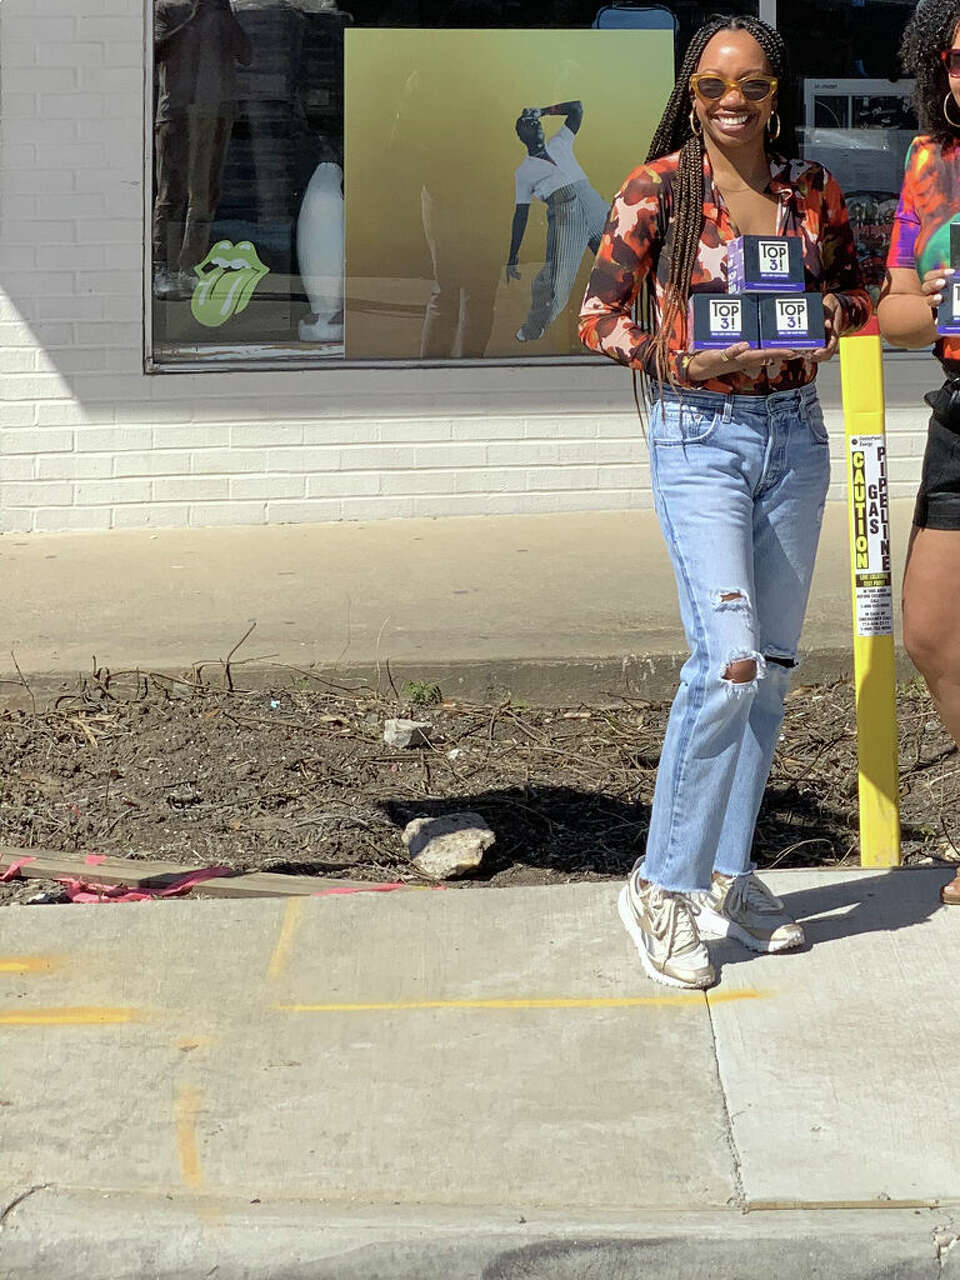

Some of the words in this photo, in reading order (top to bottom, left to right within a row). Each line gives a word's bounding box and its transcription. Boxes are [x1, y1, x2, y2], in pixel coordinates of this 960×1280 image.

[760, 243, 786, 258] TOP
[711, 301, 740, 317] TOP
[777, 300, 805, 316] TOP
[852, 451, 869, 570] CAUTION
[868, 484, 880, 534] GAS
[876, 446, 891, 571] PIPELINE
